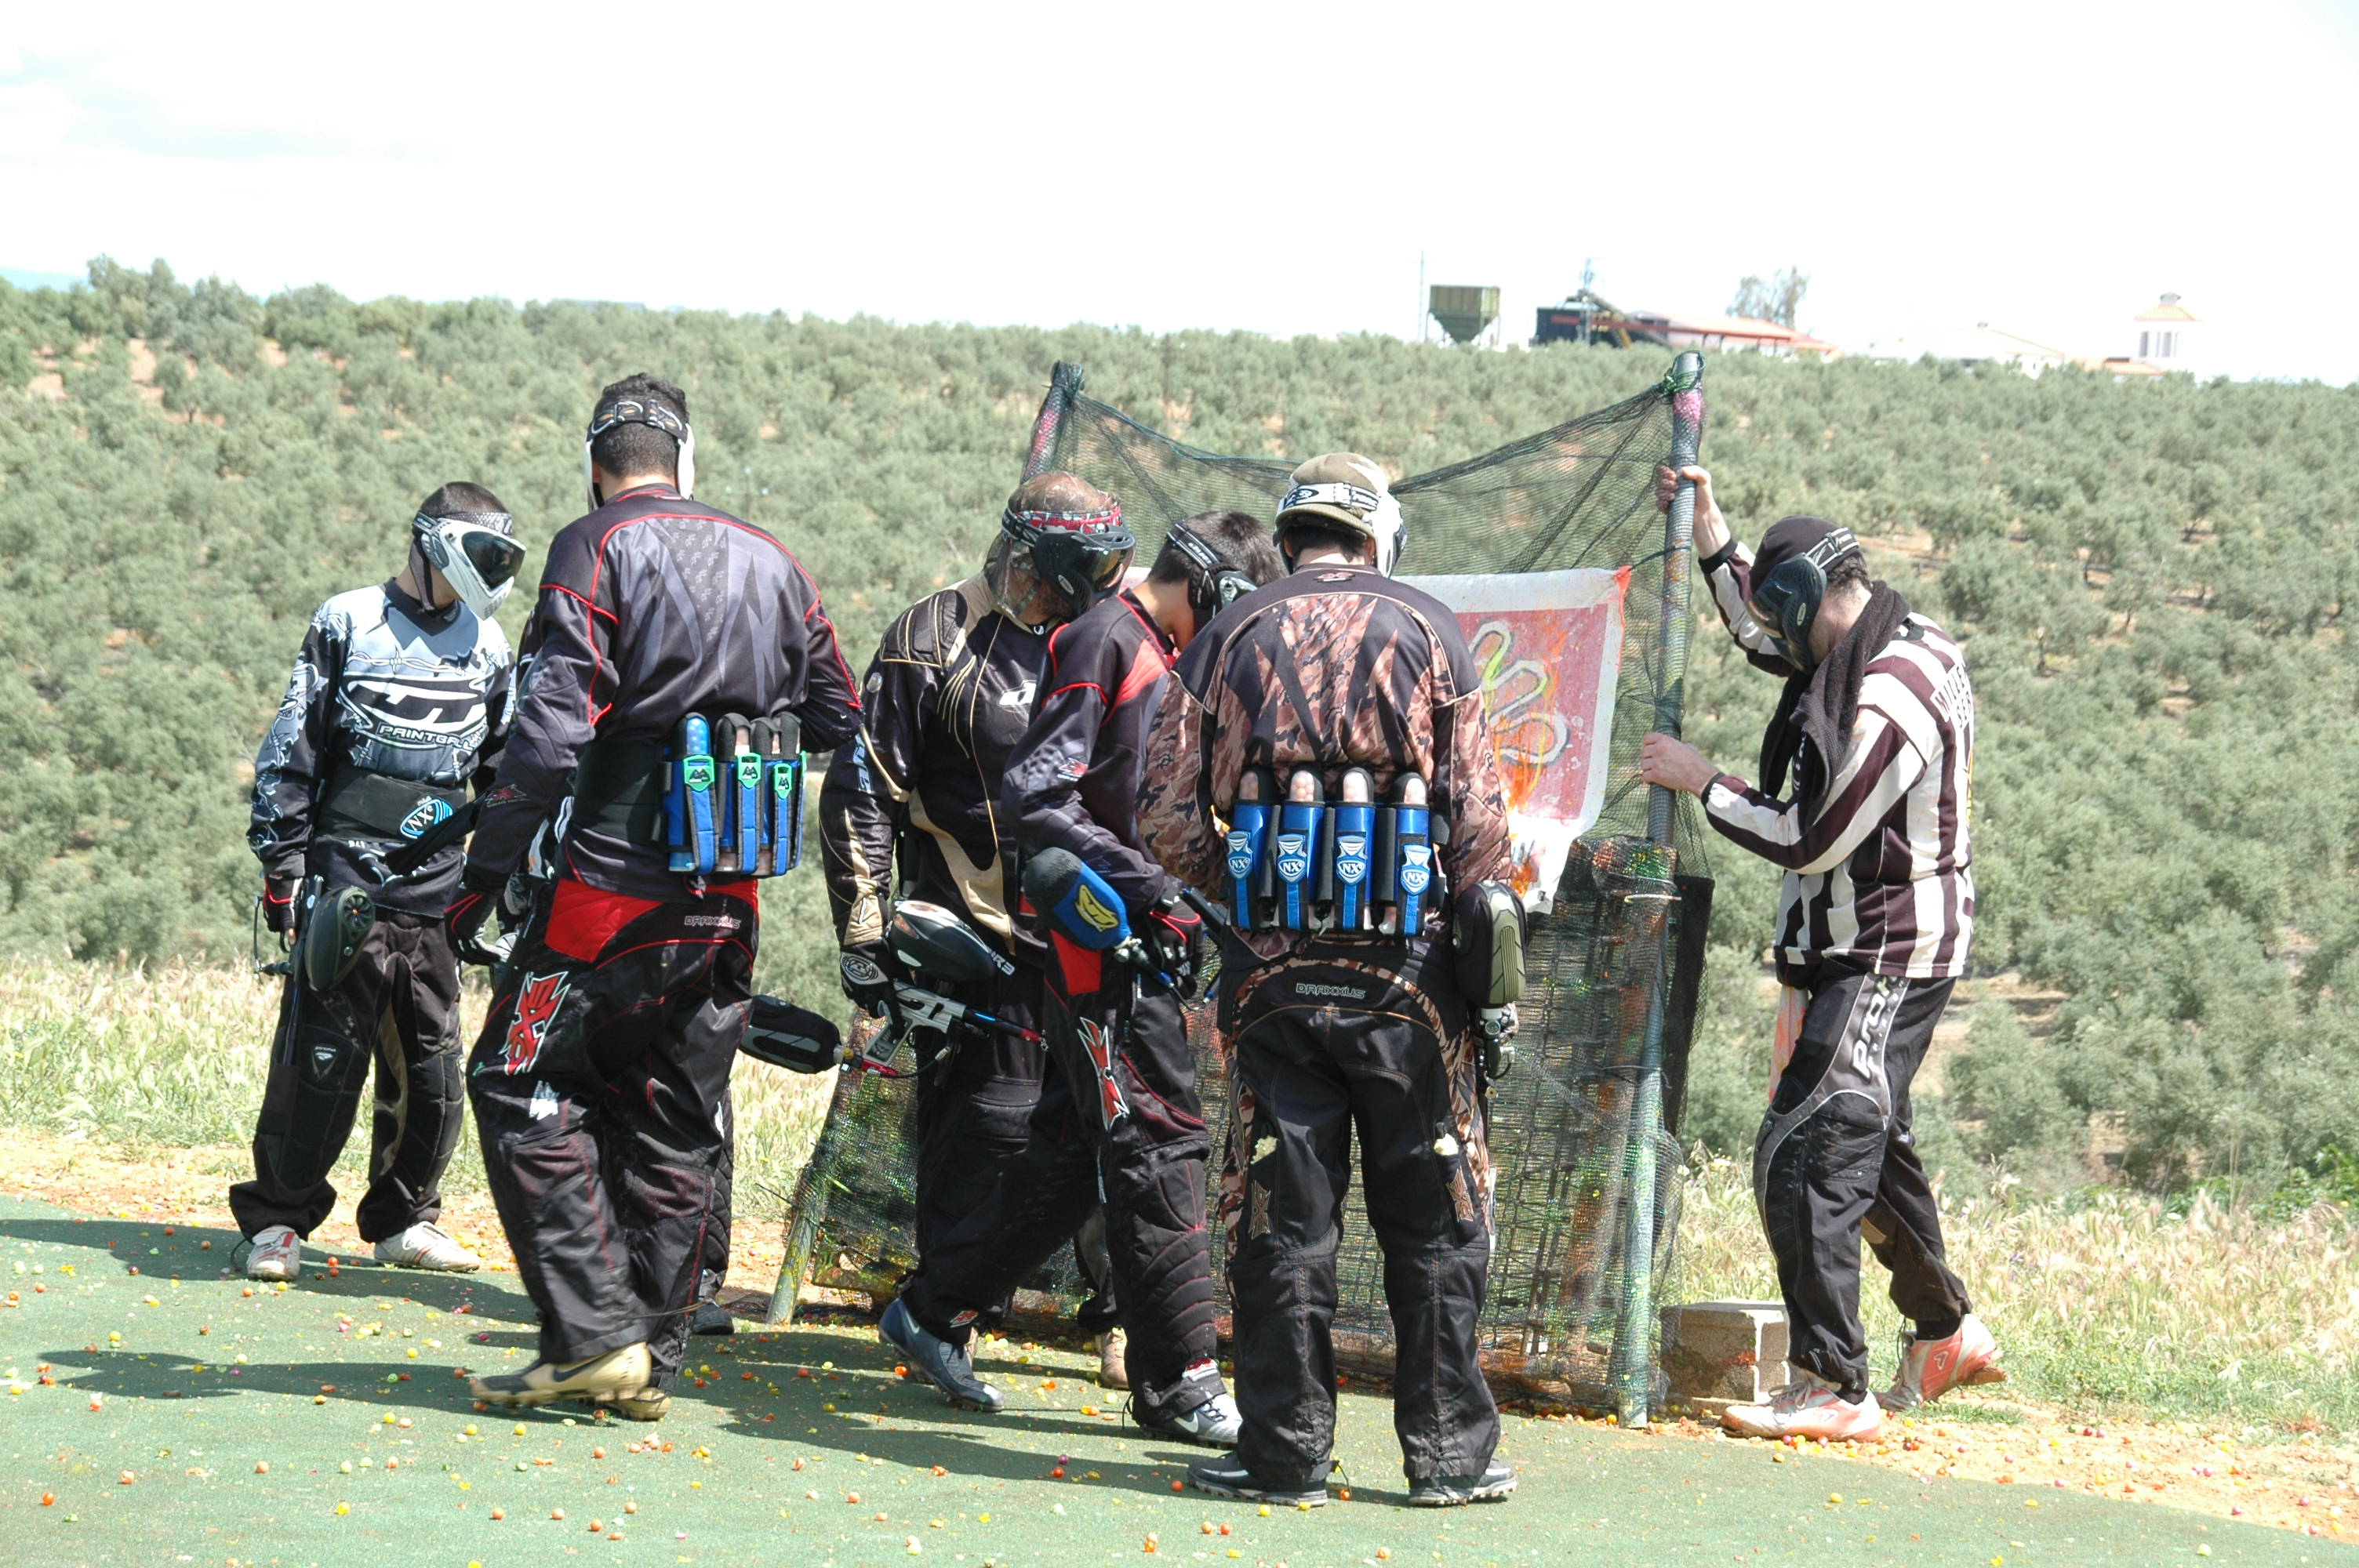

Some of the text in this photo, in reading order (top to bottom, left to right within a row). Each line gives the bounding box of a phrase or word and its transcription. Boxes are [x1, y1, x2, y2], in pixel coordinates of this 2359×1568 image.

[380, 724, 474, 751] PAINTBALL
[684, 915, 742, 929] DRAXXUS
[1296, 982, 1366, 1000] DRAXXUS
